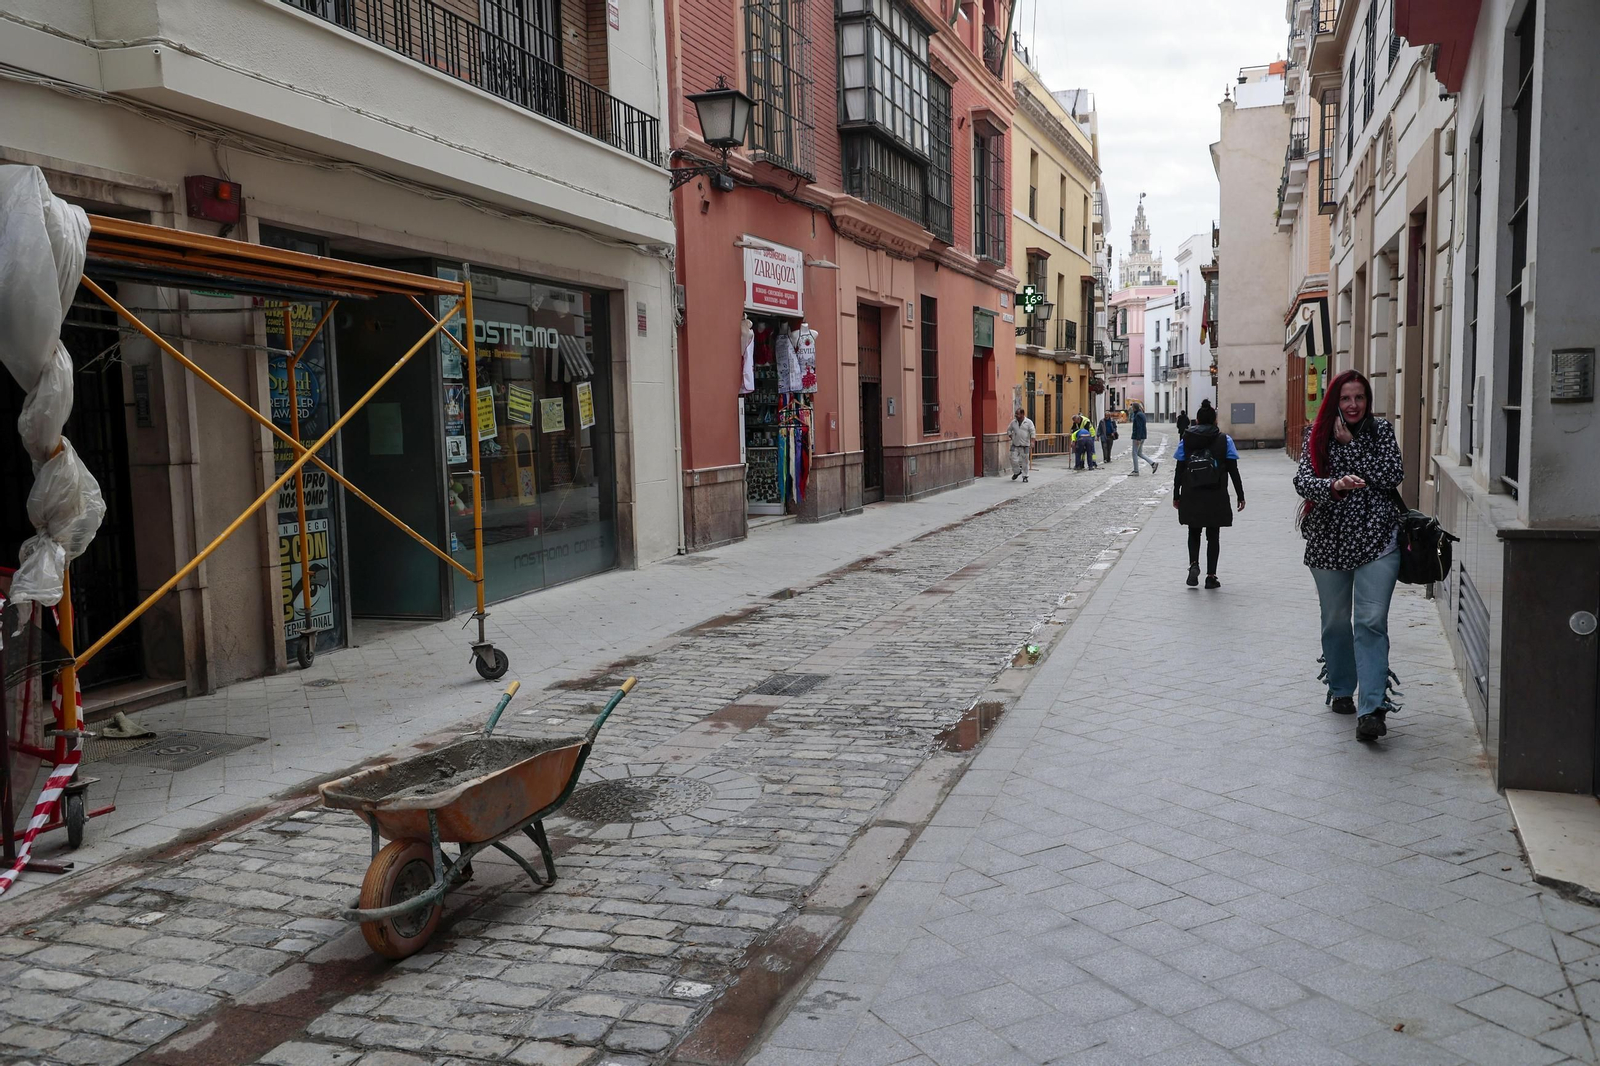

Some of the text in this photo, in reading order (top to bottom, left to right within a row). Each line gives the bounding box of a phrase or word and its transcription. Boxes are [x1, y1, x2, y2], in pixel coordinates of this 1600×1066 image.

[754, 258, 796, 285] ZARAGOZA
[1229, 368, 1276, 379] AMARA
[268, 371, 311, 394] Sprit
[270, 397, 314, 408] RETALER
[273, 408, 310, 418] AWRD
[293, 521, 327, 533] DEGO
[292, 531, 327, 563] CON
[513, 544, 570, 570] NOSTROMO
